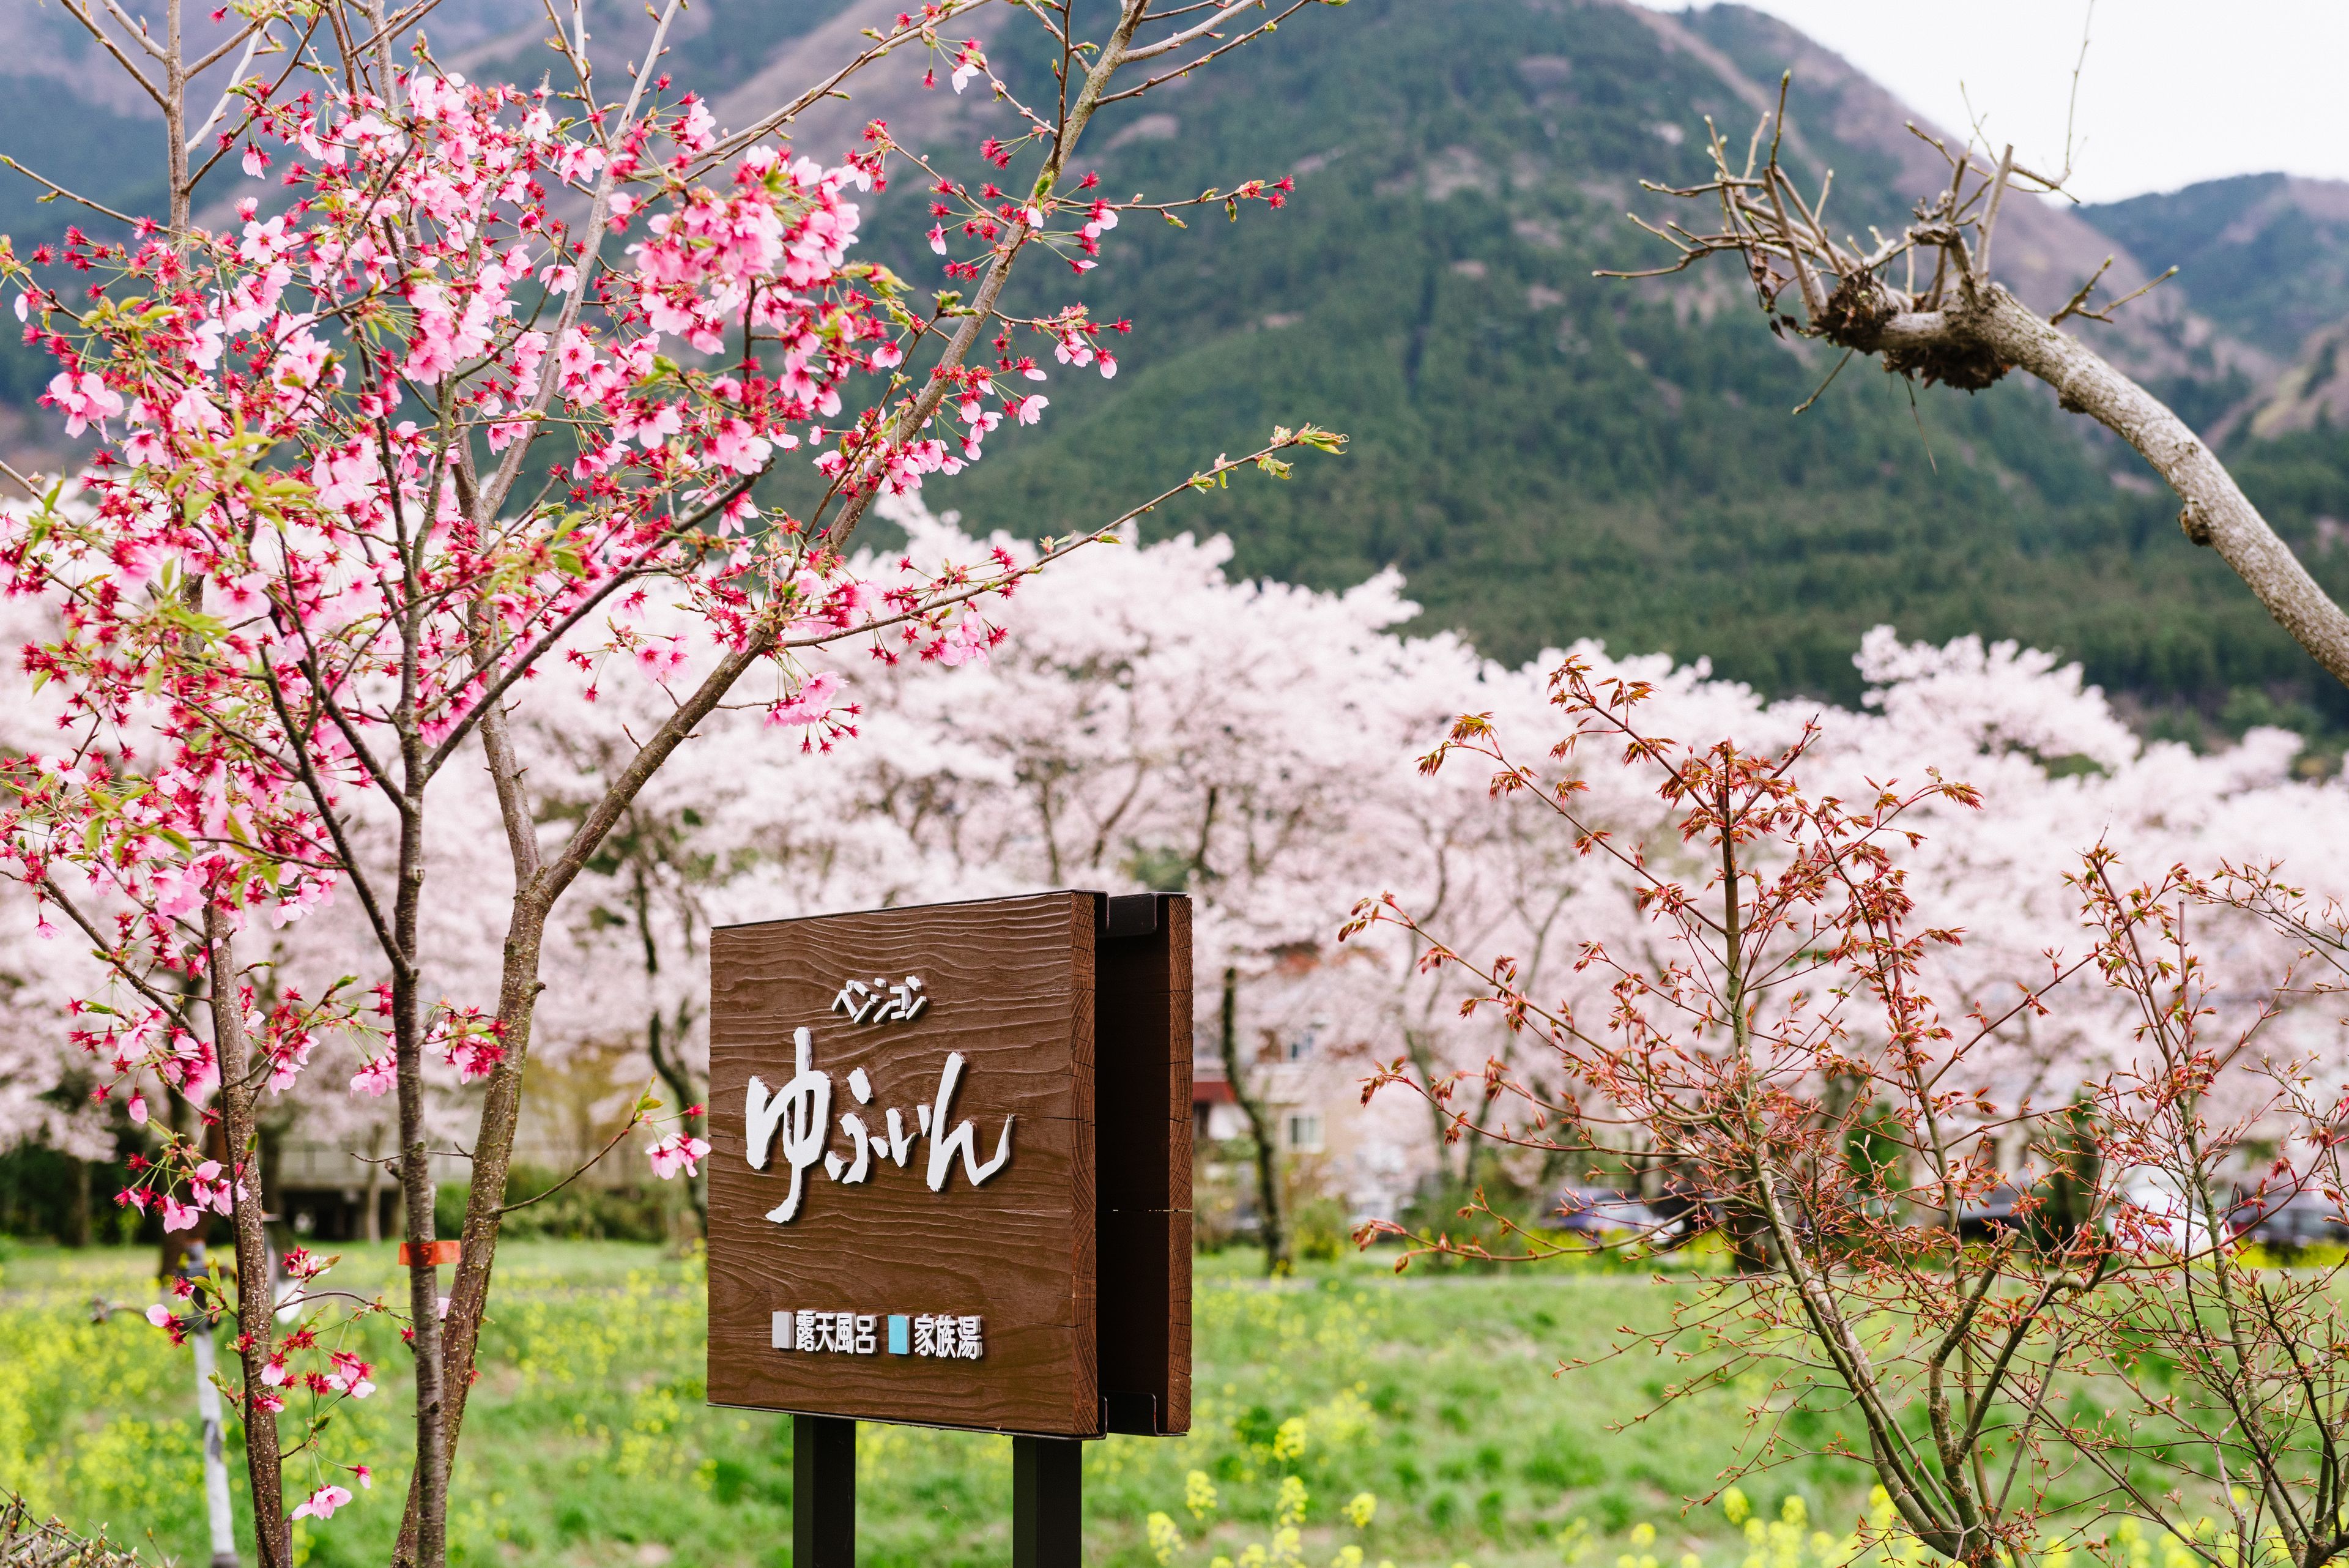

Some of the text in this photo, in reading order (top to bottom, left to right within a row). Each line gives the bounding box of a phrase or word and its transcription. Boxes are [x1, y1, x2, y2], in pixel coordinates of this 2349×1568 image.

[831, 976, 927, 1024] ペンション
[746, 1027, 1015, 1223] ゆふいん
[796, 1310, 982, 1359] 露天風呂 家族湯
